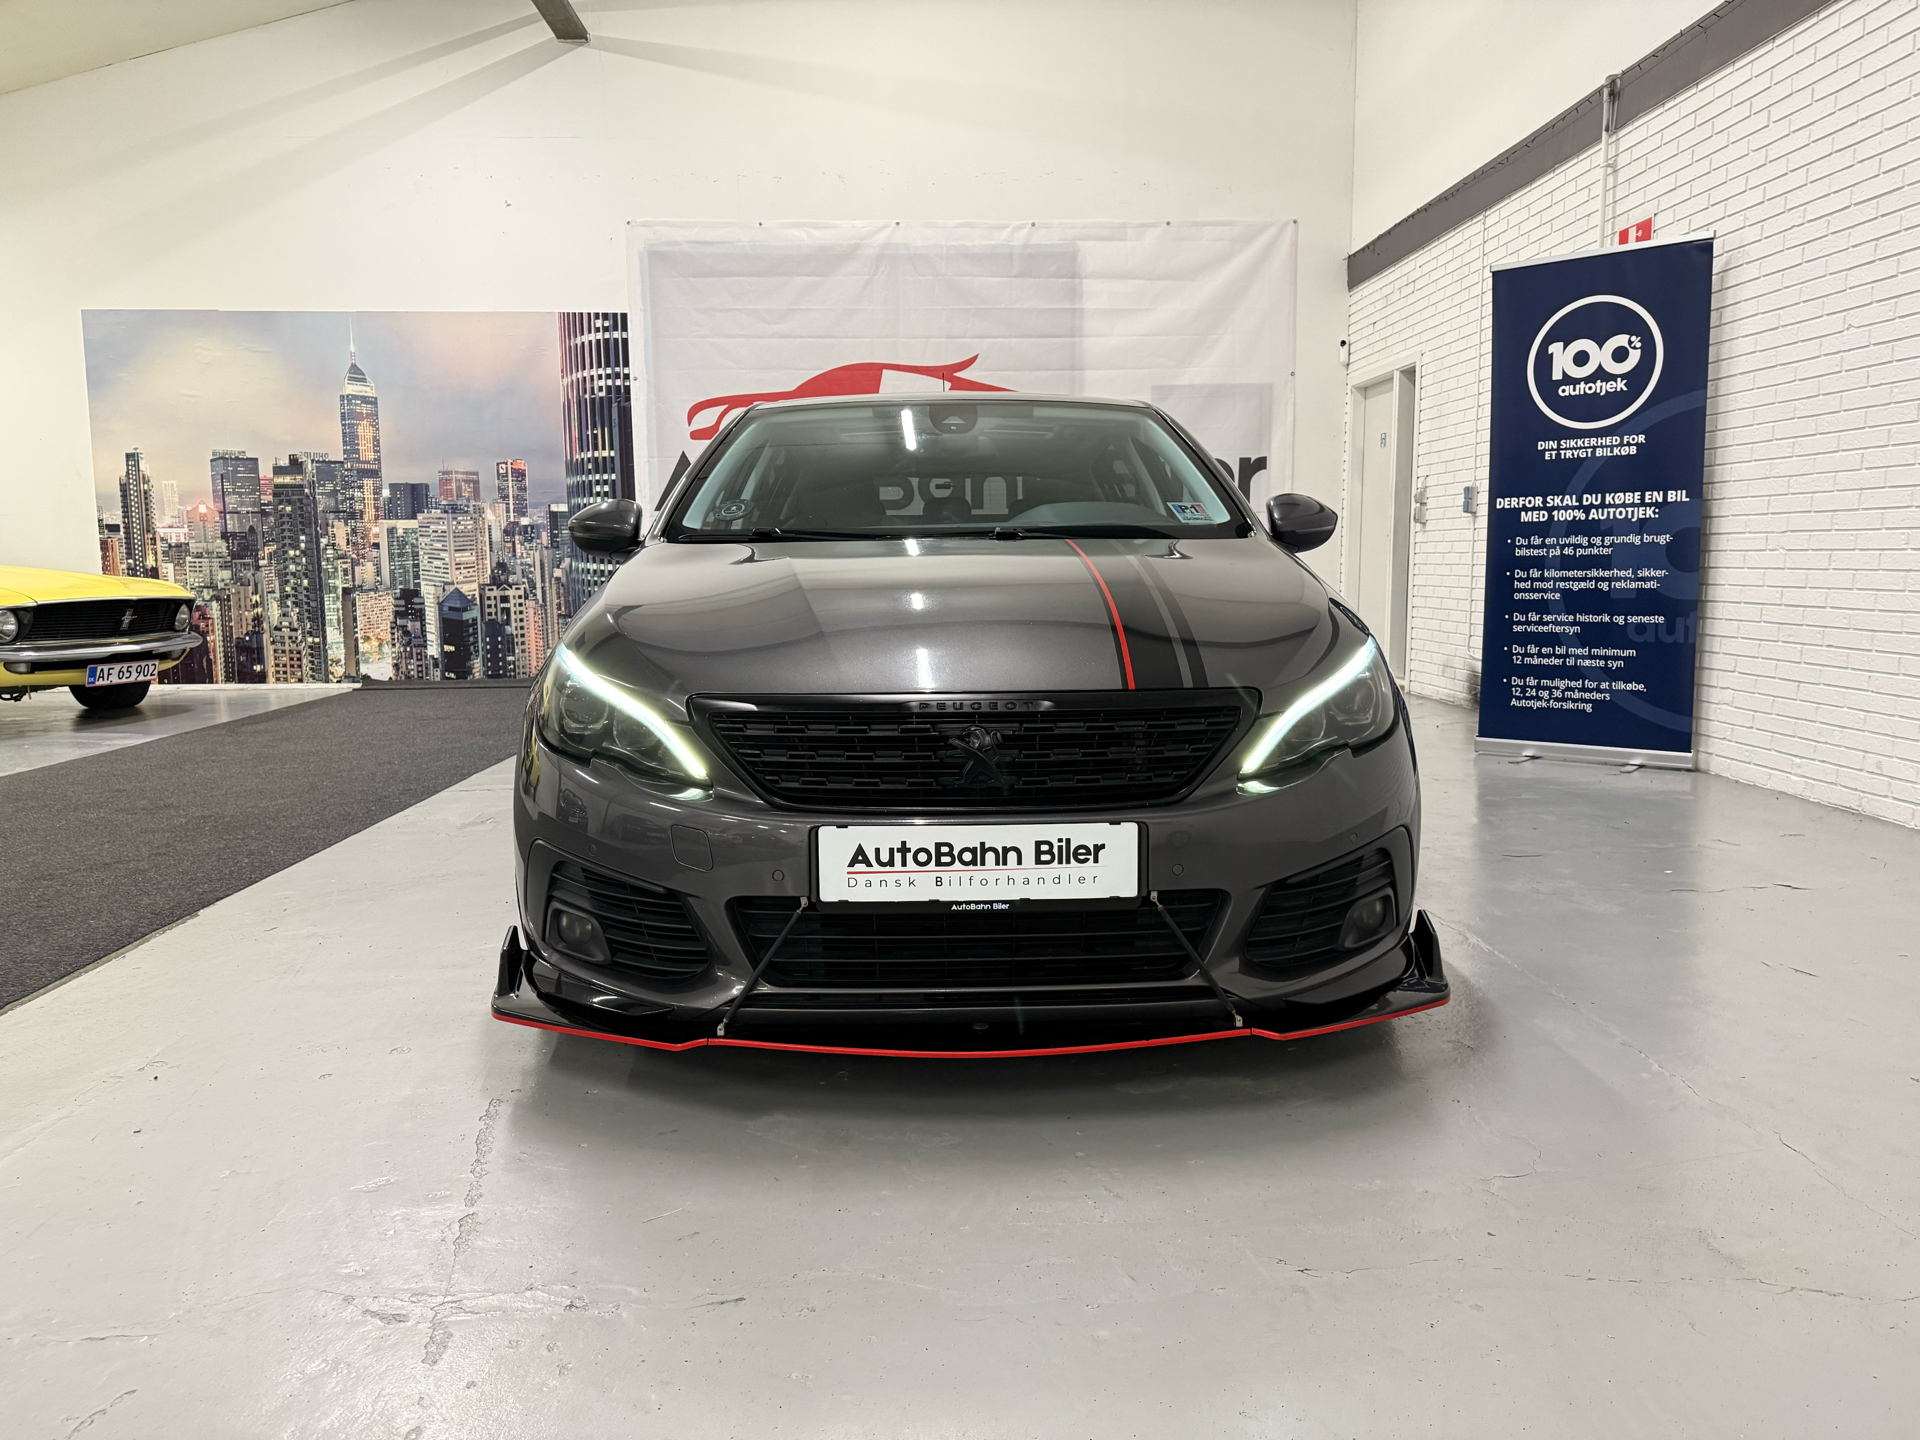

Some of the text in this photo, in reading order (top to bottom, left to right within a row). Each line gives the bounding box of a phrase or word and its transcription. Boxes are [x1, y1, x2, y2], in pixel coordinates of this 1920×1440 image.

[1548, 333, 1642, 380] 100%
[1558, 378, 1627, 396] autotjek
[1538, 435, 1645, 450] DIN SIKKERHED FOR
[1545, 446, 1636, 460] ET TRYGT BILKØB
[1496, 490, 1689, 508] DERFOR SKAL DU KØBE EN BIL
[1521, 507, 1658, 522] MED 100% AUTOTJEK:
[1516, 537, 1528, 545] Du
[1531, 536, 1543, 544] får
[1559, 535, 1588, 546] uvildig
[1591, 537, 1602, 546] og
[1604, 534, 1641, 545] grundig
[1644, 534, 1673, 544] brugt-
[1516, 546, 1613, 558] bilstest på 46 punkter
[1515, 568, 1668, 578] Du får kilometersikkerhed, sikker-
[1514, 580, 1660, 591] hed mod restgæld og reklamati-
[1514, 591, 1560, 599] onsservice
[1514, 613, 1525, 621] Du
[1528, 612, 1540, 621] får
[1543, 613, 1574, 621] service
[1577, 613, 1610, 622] historik
[1613, 616, 1624, 625] og
[1513, 624, 1580, 635] serviceeftersyn
[1513, 645, 1524, 653] Du
[1527, 644, 1539, 653] får
[1556, 646, 1566, 654] bil
[1569, 646, 1588, 655] med
[1592, 647, 1636, 656] minimum
[1524, 655, 1564, 665] måneder
[1566, 657, 1574, 665] til
[1608, 660, 1623, 669] syn
[96, 663, 157, 682] AF 65 902
[1512, 677, 1523, 685] Du
[1526, 677, 1538, 686] får
[1541, 678, 1582, 689] mulighed
[1585, 680, 1598, 688] for
[1612, 681, 1646, 692] tilkøbe,
[1512, 688, 1610, 700] 12, 24 og 36 måneders
[918, 701, 1034, 711] PEUGEOT
[1511, 698, 1592, 712] Autotjek-forsikring
[847, 838, 1105, 867] AutoBahn Biler
[848, 874, 1097, 887] Dansk Bilforhandler
